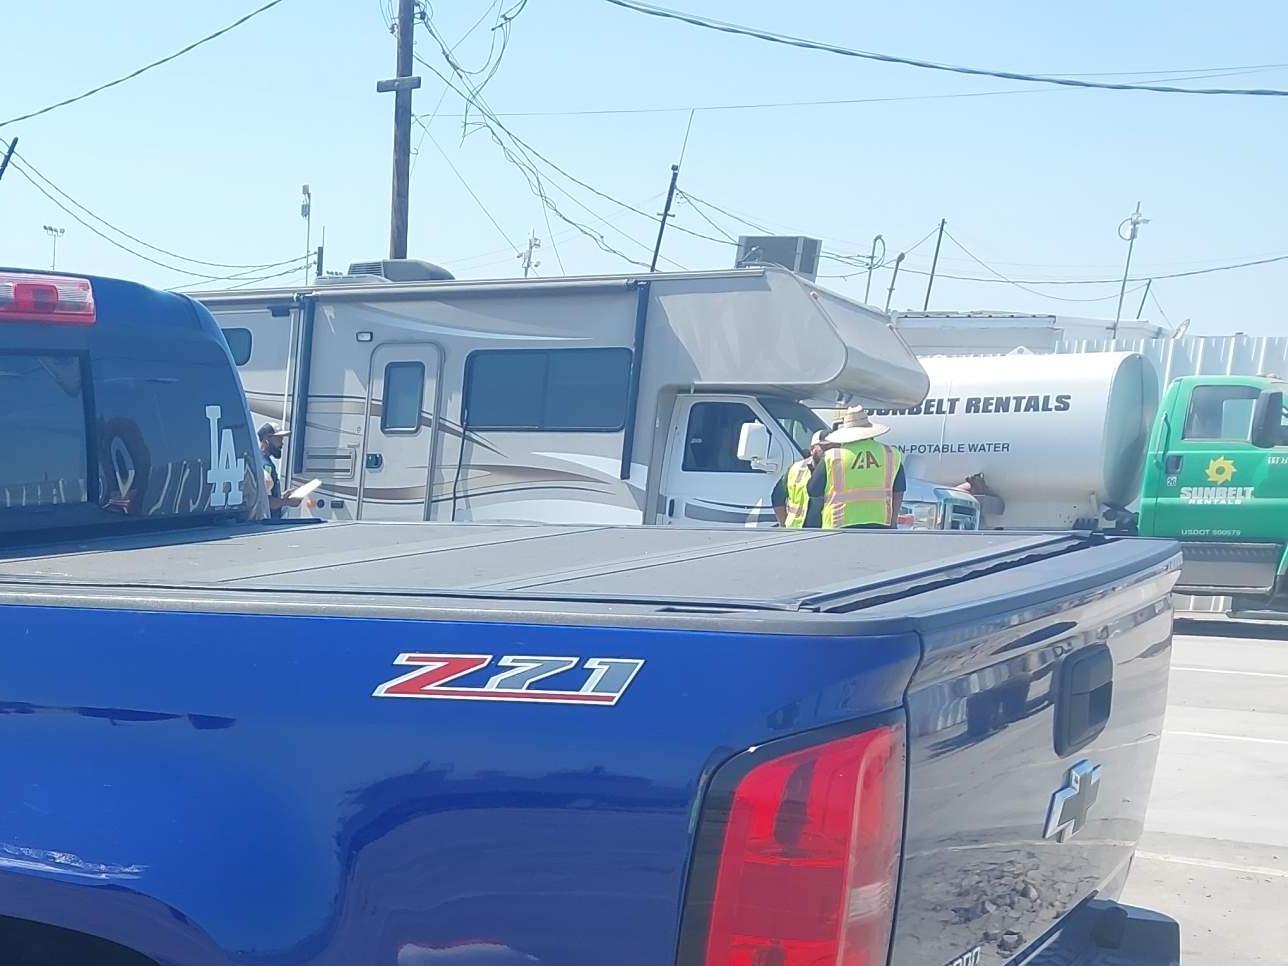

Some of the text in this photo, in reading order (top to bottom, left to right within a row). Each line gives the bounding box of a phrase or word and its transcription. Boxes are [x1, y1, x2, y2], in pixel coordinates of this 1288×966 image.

[965, 394, 1072, 414] RENTALS
[968, 442, 1011, 453] WATER
[205, 405, 245, 507] LA
[1179, 486, 1255, 499] SUNBELT
[1181, 528, 1210, 536] USDOT
[372, 652, 646, 706] Z71
